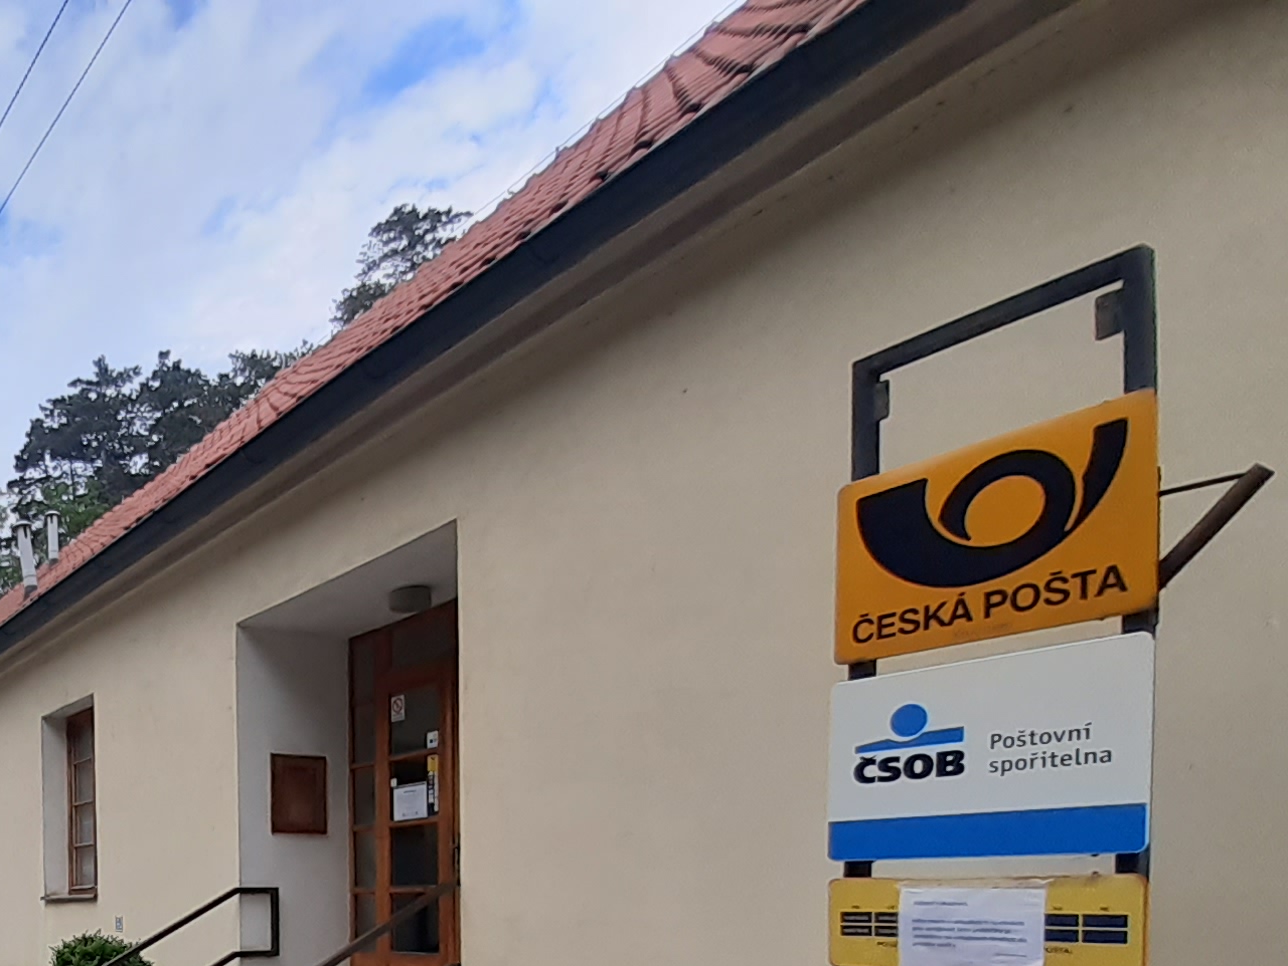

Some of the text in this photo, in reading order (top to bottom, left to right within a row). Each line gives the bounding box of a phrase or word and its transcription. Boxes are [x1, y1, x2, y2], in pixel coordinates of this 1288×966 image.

[852, 565, 1128, 644] ČESKÁ POŠTA
[989, 722, 1093, 750] Poštovní
[853, 750, 966, 784] ČSOB
[989, 748, 1113, 777] spořitelna
